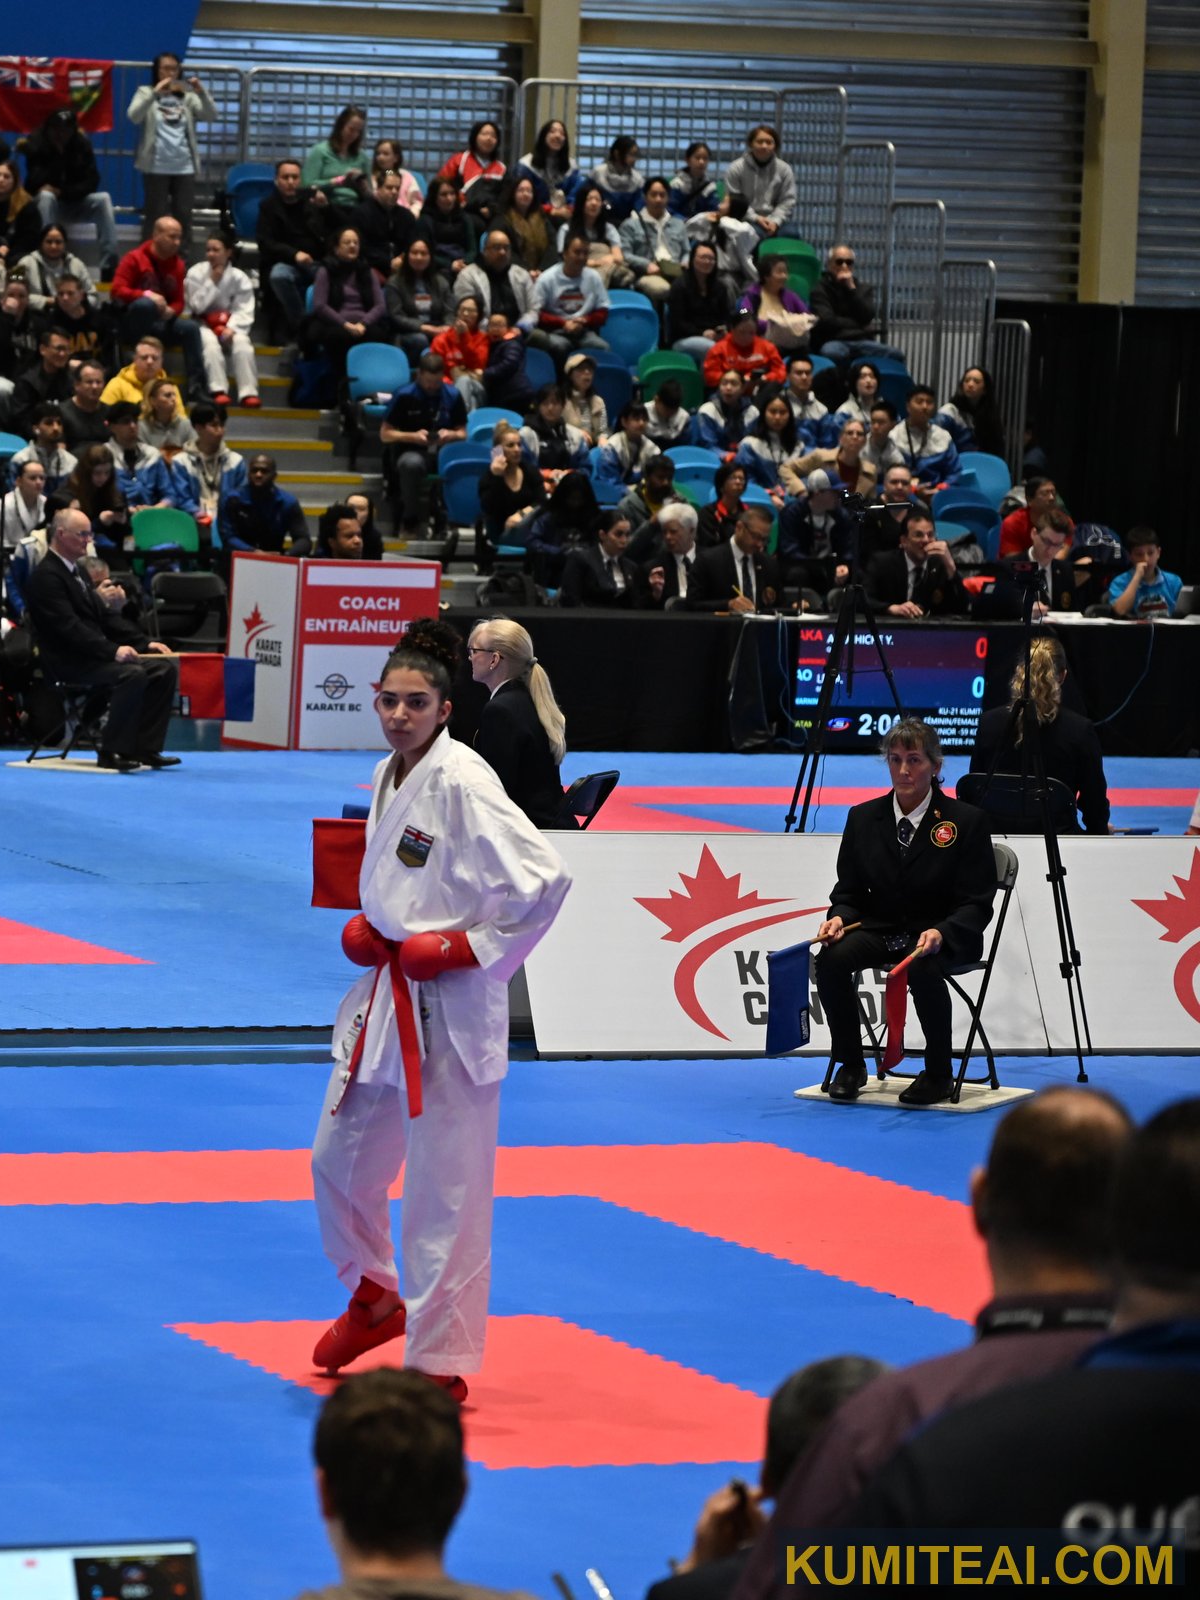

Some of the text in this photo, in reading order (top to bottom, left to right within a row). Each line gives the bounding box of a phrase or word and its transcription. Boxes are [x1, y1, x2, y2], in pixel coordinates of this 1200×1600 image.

[339, 596, 400, 611] COACH
[255, 638, 282, 654] KARATE
[975, 637, 988, 659] 0
[255, 652, 282, 667] CANADA
[972, 675, 985, 698] 0
[306, 703, 362, 712] KARATE BC
